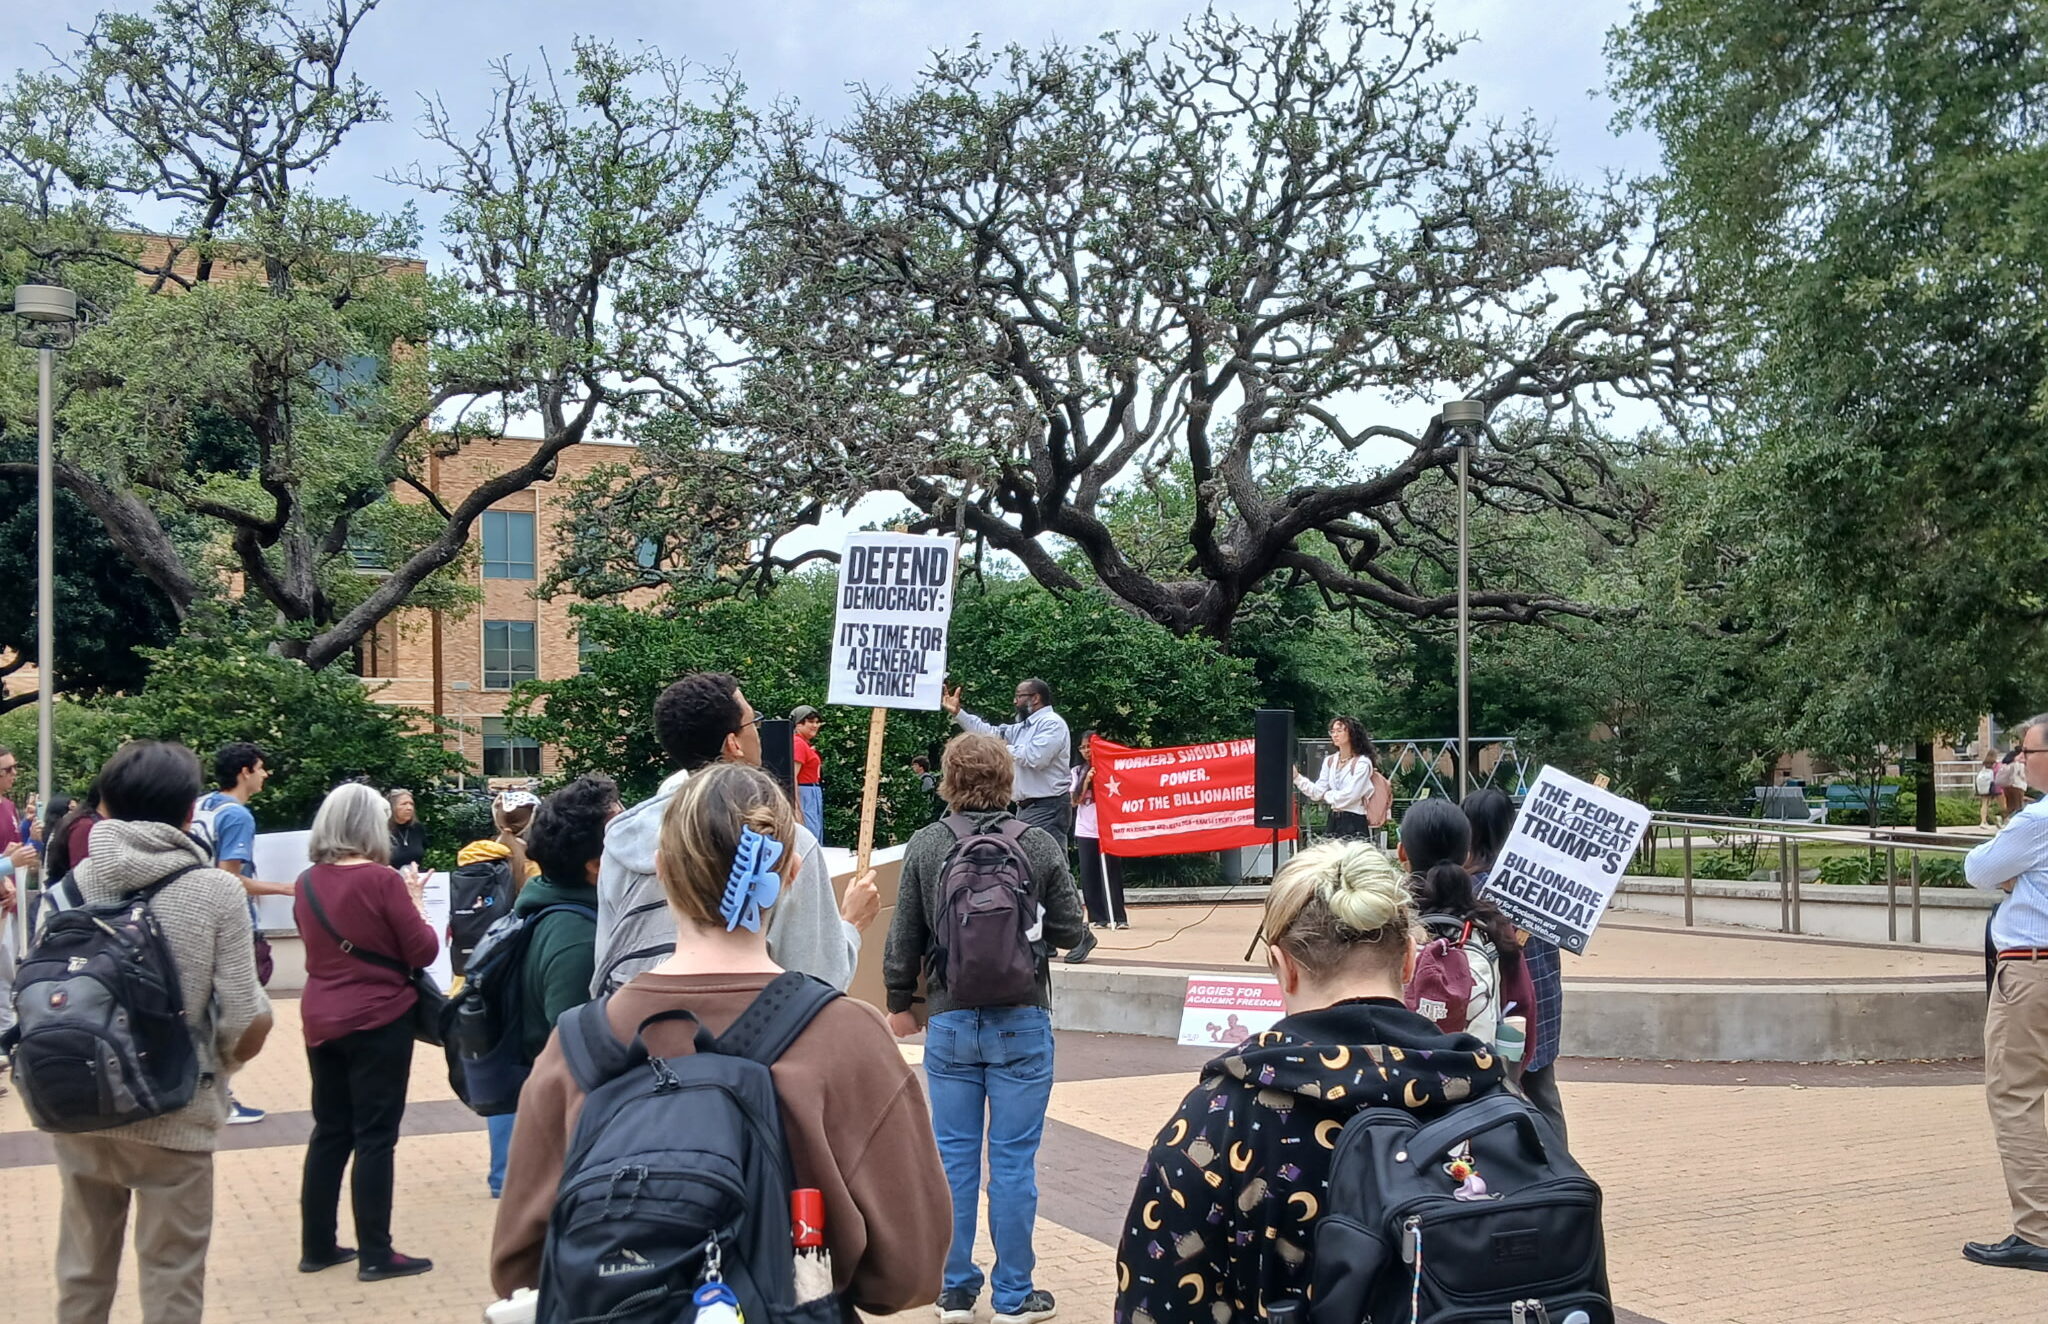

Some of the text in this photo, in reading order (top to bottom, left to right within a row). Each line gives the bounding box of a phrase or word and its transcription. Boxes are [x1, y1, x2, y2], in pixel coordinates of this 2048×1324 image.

[847, 546, 948, 586] DEFEND
[843, 586, 944, 612] DEMOCRACY:
[840, 623, 942, 651] IT'S TIME FOR
[847, 647, 928, 674] A GENERAL
[856, 672, 916, 698] STRIKE!
[1114, 739, 1255, 770] WORKERS SHOULD HAV
[1160, 768, 1210, 787] POWER.
[1122, 799, 1145, 813] NOT
[1148, 796, 1170, 810] THE
[1536, 781, 1639, 839] THE PEOPLE
[1530, 798, 1631, 853] WILL DEFEAT
[1521, 813, 1622, 874] TRUMP'S
[1503, 851, 1603, 908] BILLIONAIRE
[1492, 869, 1594, 929] AGENDA!
[1512, 905, 1544, 926] Socialism
[1543, 920, 1558, 930] and
[1187, 996, 1282, 1007] ACADEMIC FREEDOM
[1188, 986, 1262, 997] AGGIES FOR
